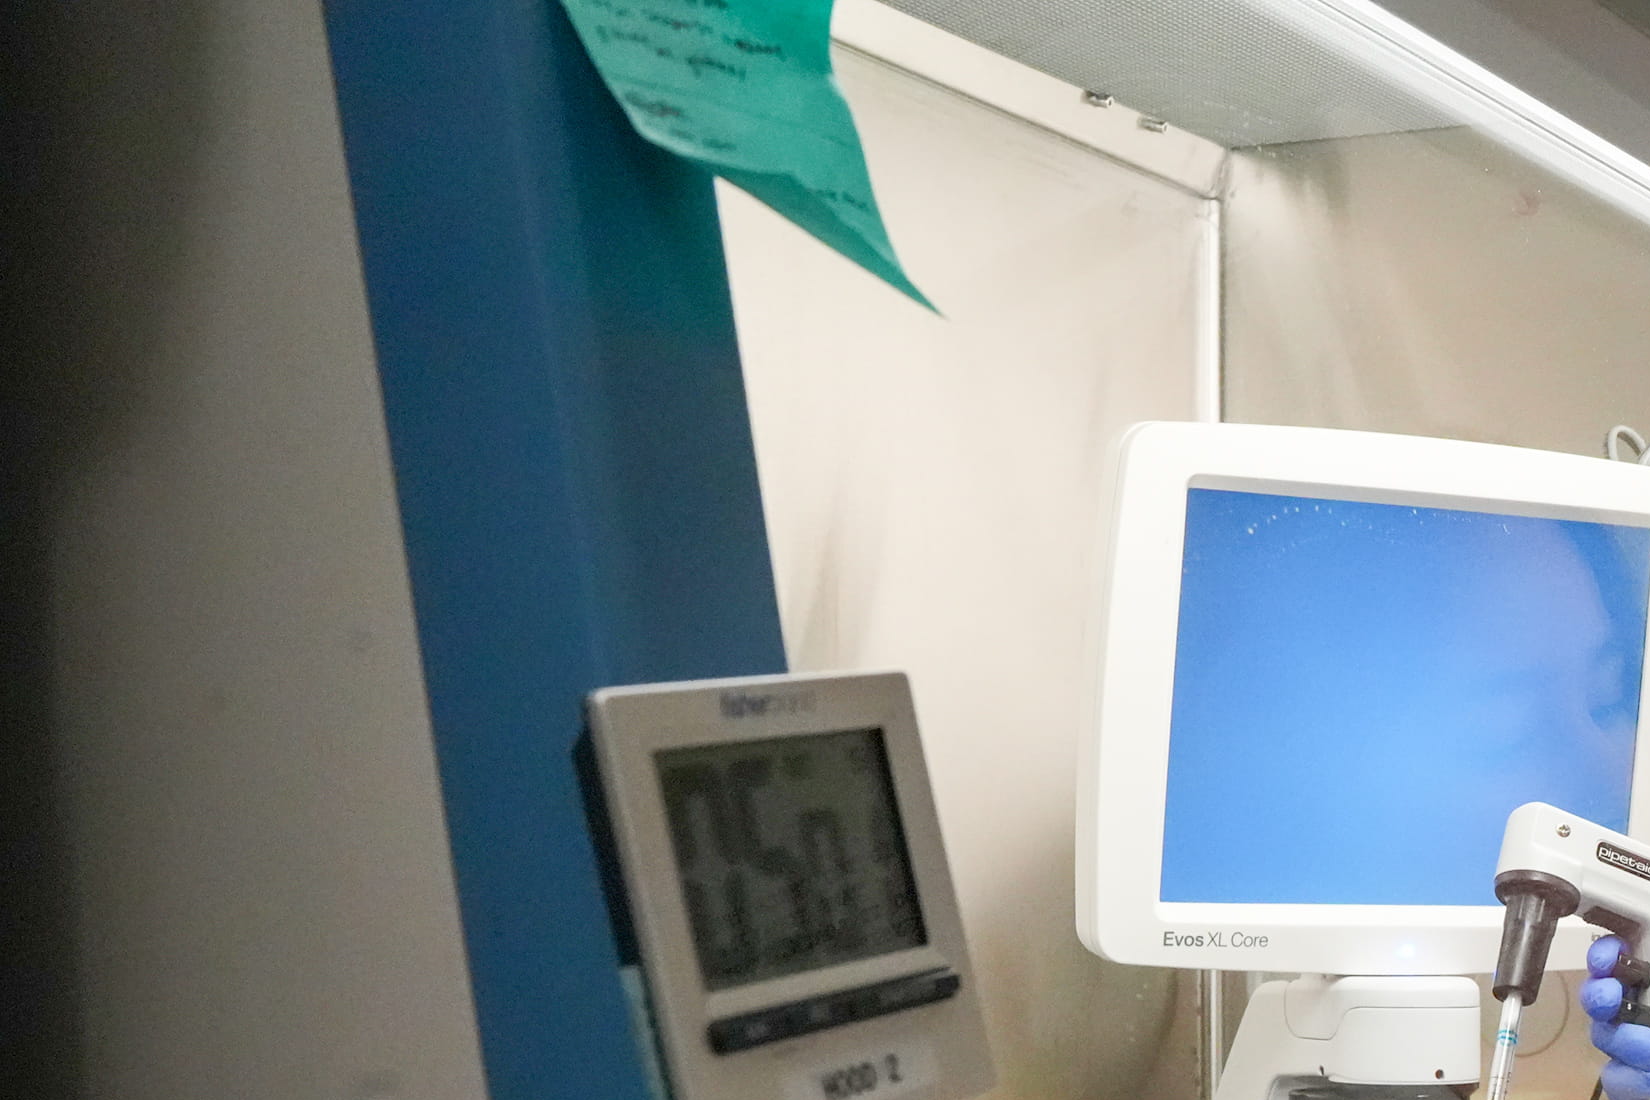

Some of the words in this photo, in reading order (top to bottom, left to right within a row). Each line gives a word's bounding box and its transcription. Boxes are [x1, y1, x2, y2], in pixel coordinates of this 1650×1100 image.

[1163, 931, 1204, 947] Evos
[1206, 931, 1228, 948] XL
[1231, 931, 1269, 948] Core
